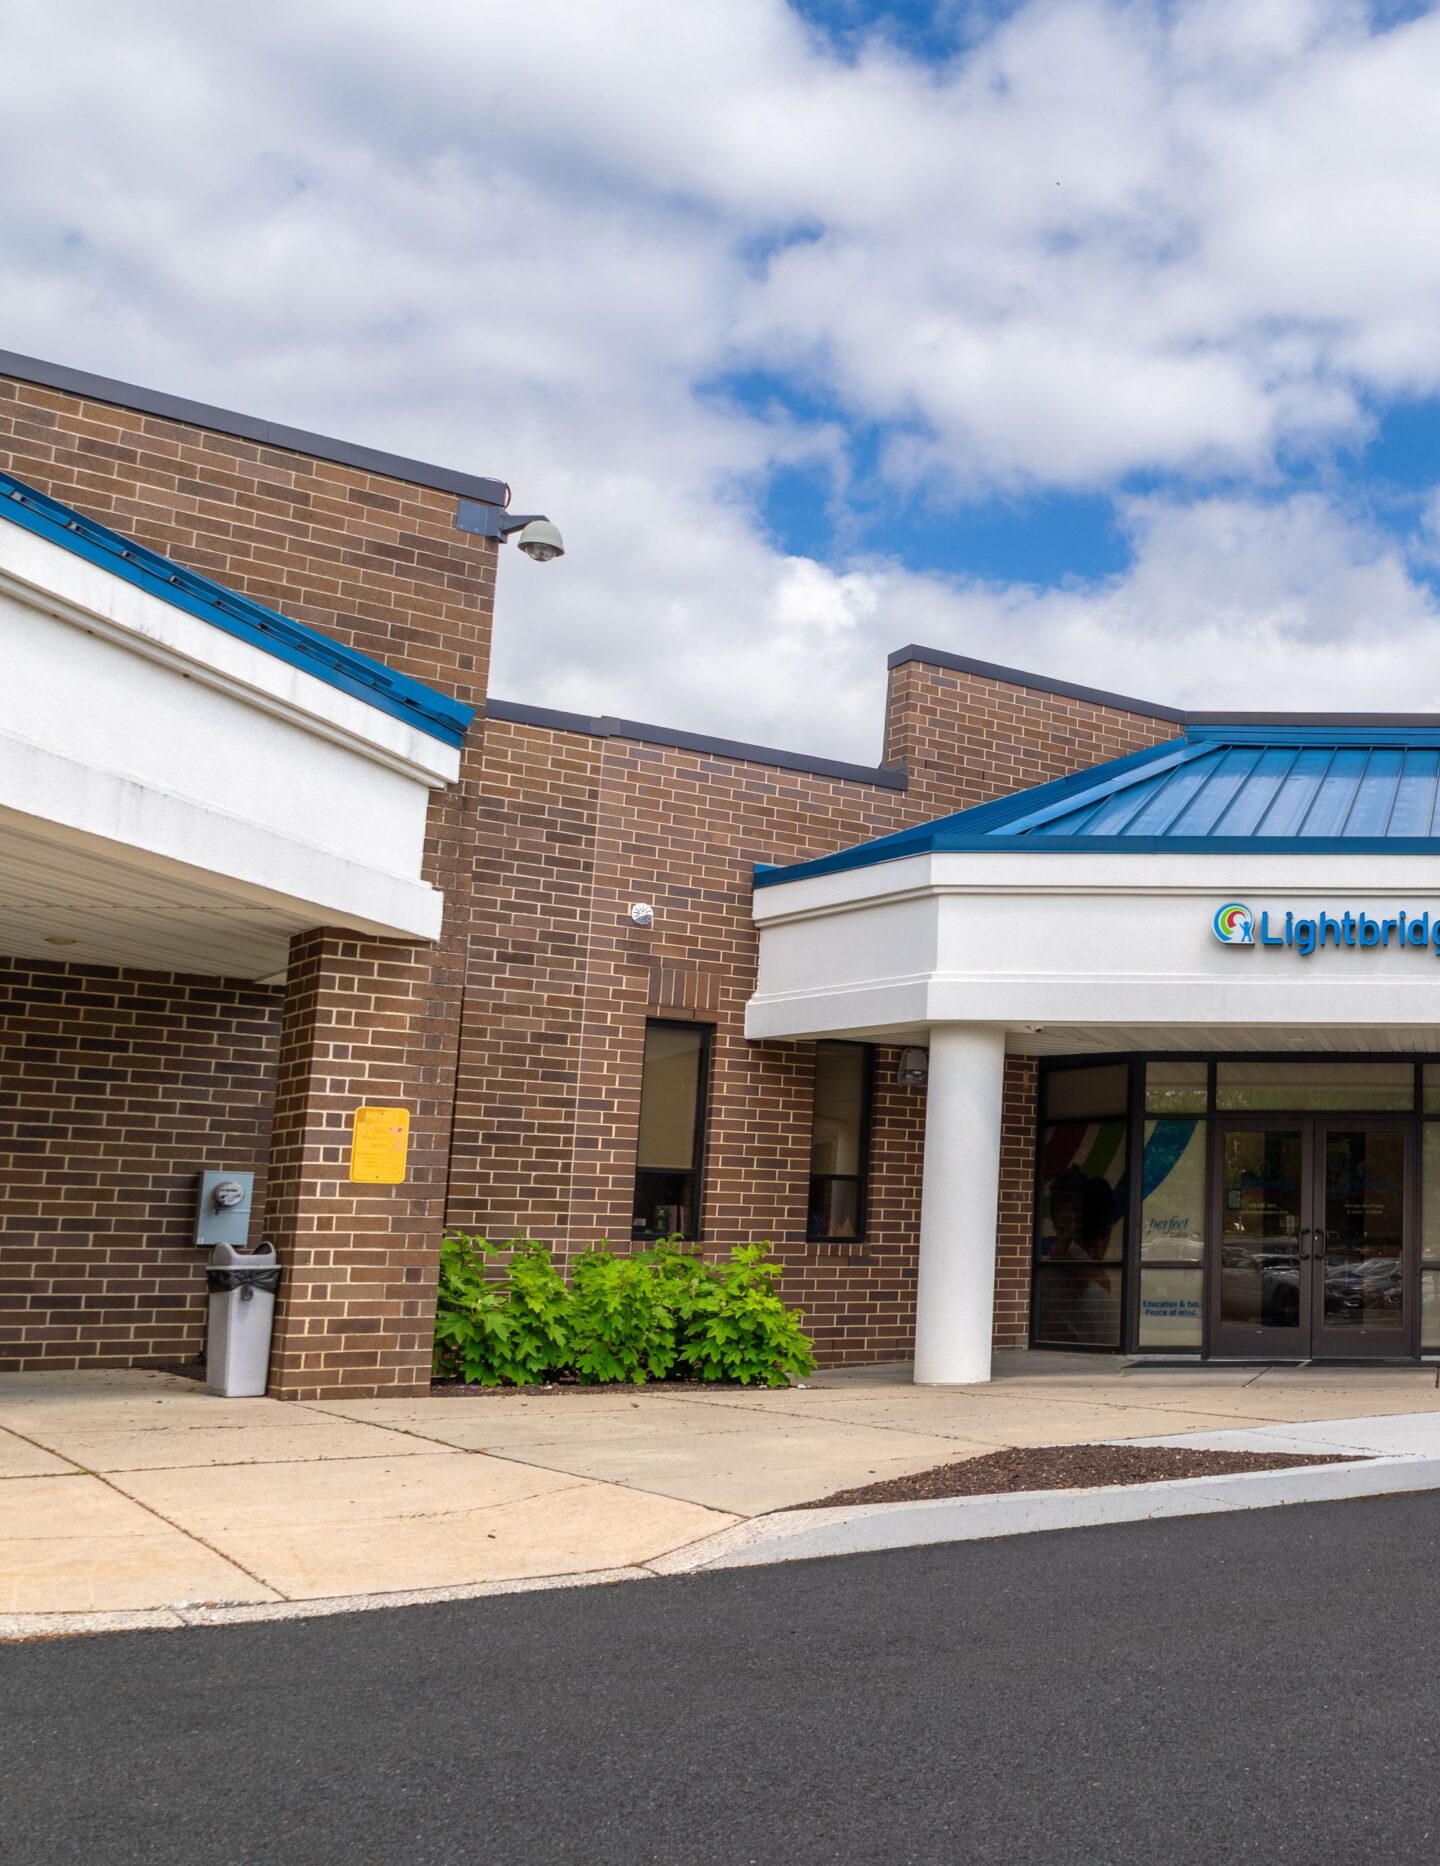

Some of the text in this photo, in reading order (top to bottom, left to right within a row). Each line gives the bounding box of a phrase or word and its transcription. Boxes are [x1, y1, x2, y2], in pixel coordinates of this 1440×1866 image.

[1147, 1216, 1189, 1234] perfect
[1142, 1300, 1177, 1308] Education
[1180, 1300, 1186, 1308] &
